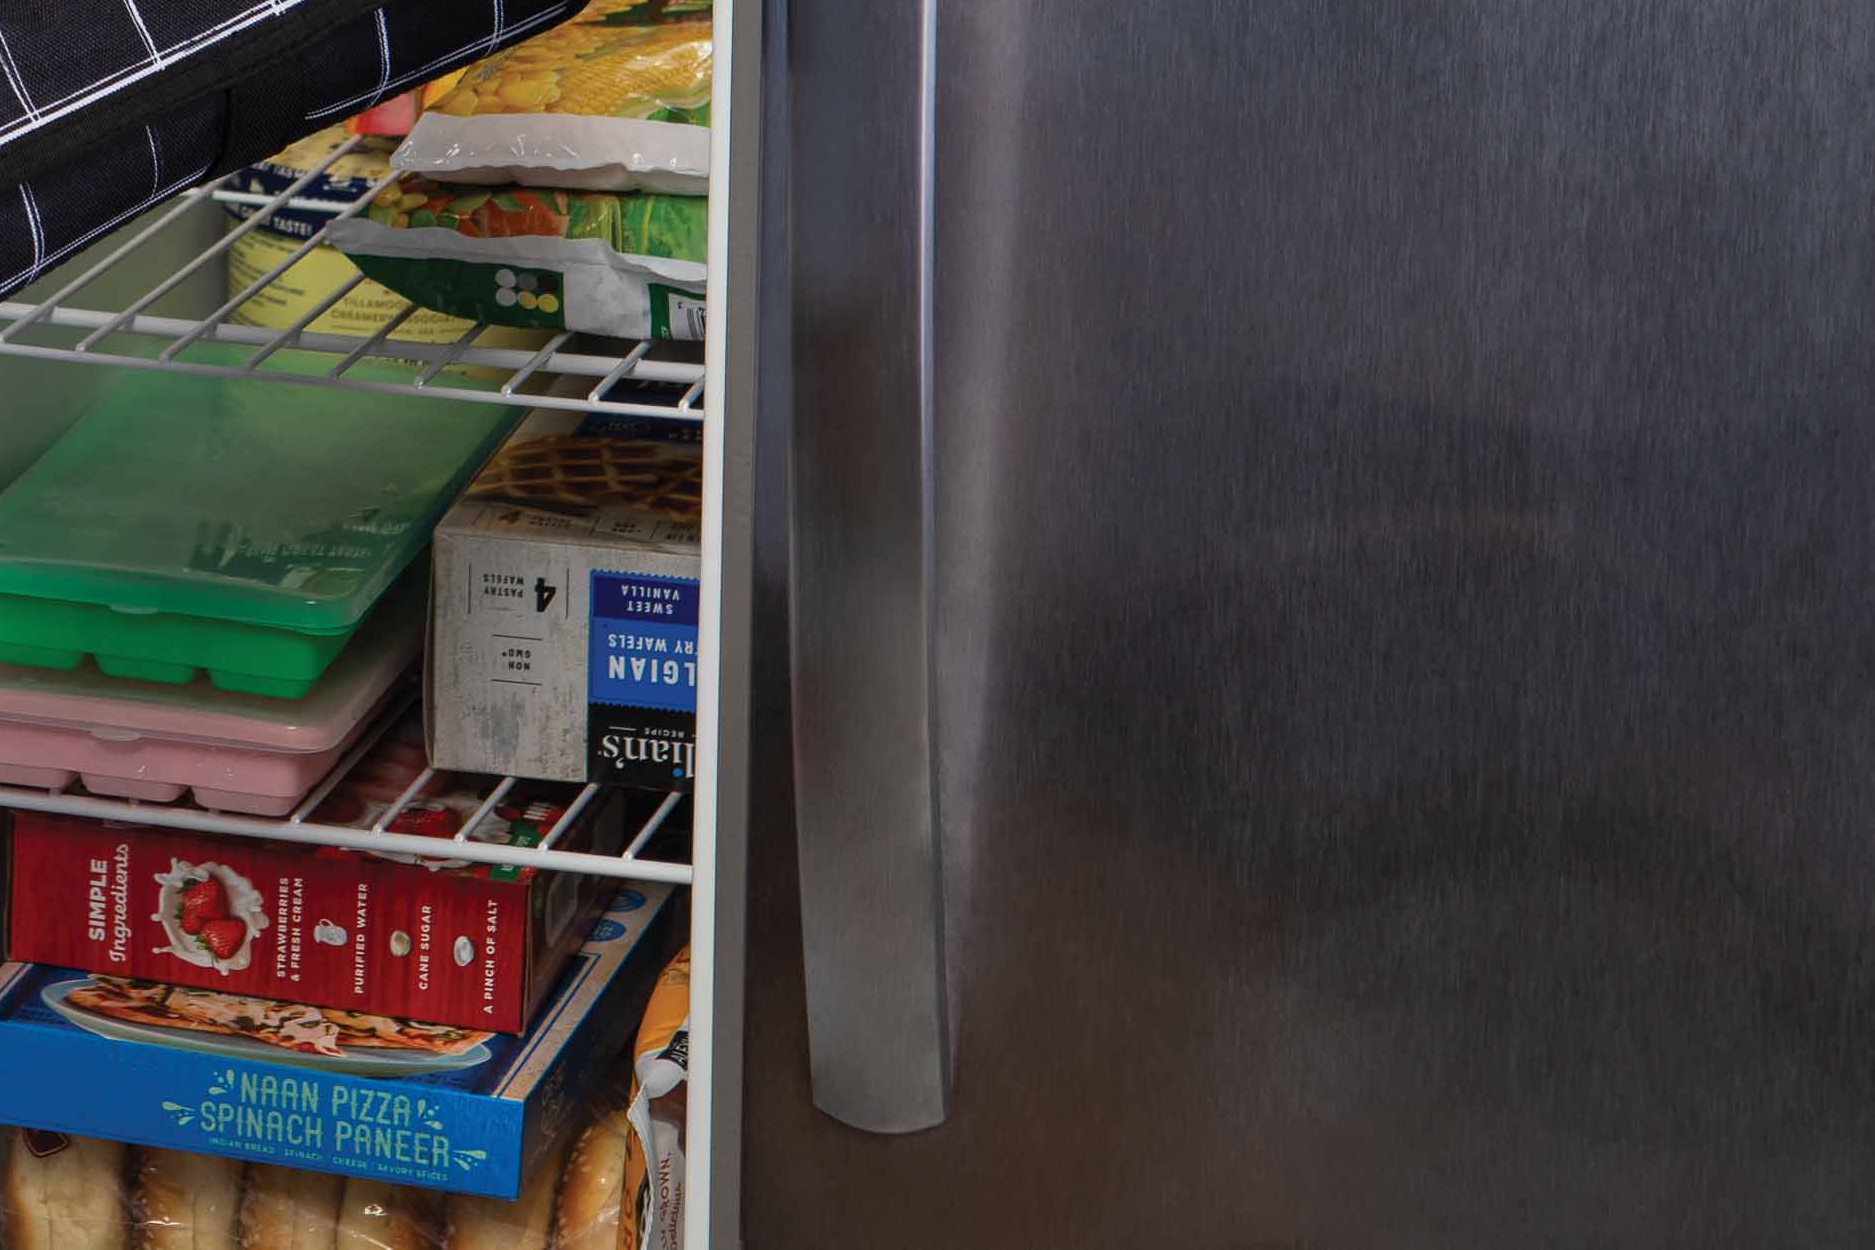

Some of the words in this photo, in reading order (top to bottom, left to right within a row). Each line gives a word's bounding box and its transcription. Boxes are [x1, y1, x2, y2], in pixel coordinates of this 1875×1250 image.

[482, 572, 525, 585] WAFELS
[534, 576, 557, 613] 4
[621, 584, 681, 601] VANILLA
[626, 600, 674, 615] SWEET
[607, 633, 668, 653] WAFELS
[508, 661, 532, 671] NON
[644, 727, 685, 738] RECIPE
[89, 858, 109, 942] SIMPLE
[108, 844, 133, 963] Ingredients
[292, 877, 304, 923] CREAM
[356, 883, 368, 929] WATER
[486, 899, 499, 933] SALT
[276, 877, 290, 978] STRAWBERRIES
[421, 905, 433, 950] SUGAR
[485, 937, 496, 954] OF
[291, 926, 303, 970] FRESH
[354, 933, 367, 994] PURIFIED
[418, 954, 430, 990] CANE
[483, 959, 495, 1001] PINCH
[482, 1005, 494, 1015] A
[240, 1071, 319, 1114] NAAN
[331, 1085, 412, 1127] PIZZA
[200, 1101, 324, 1149] SPINACH
[335, 1121, 450, 1167] PANEER
